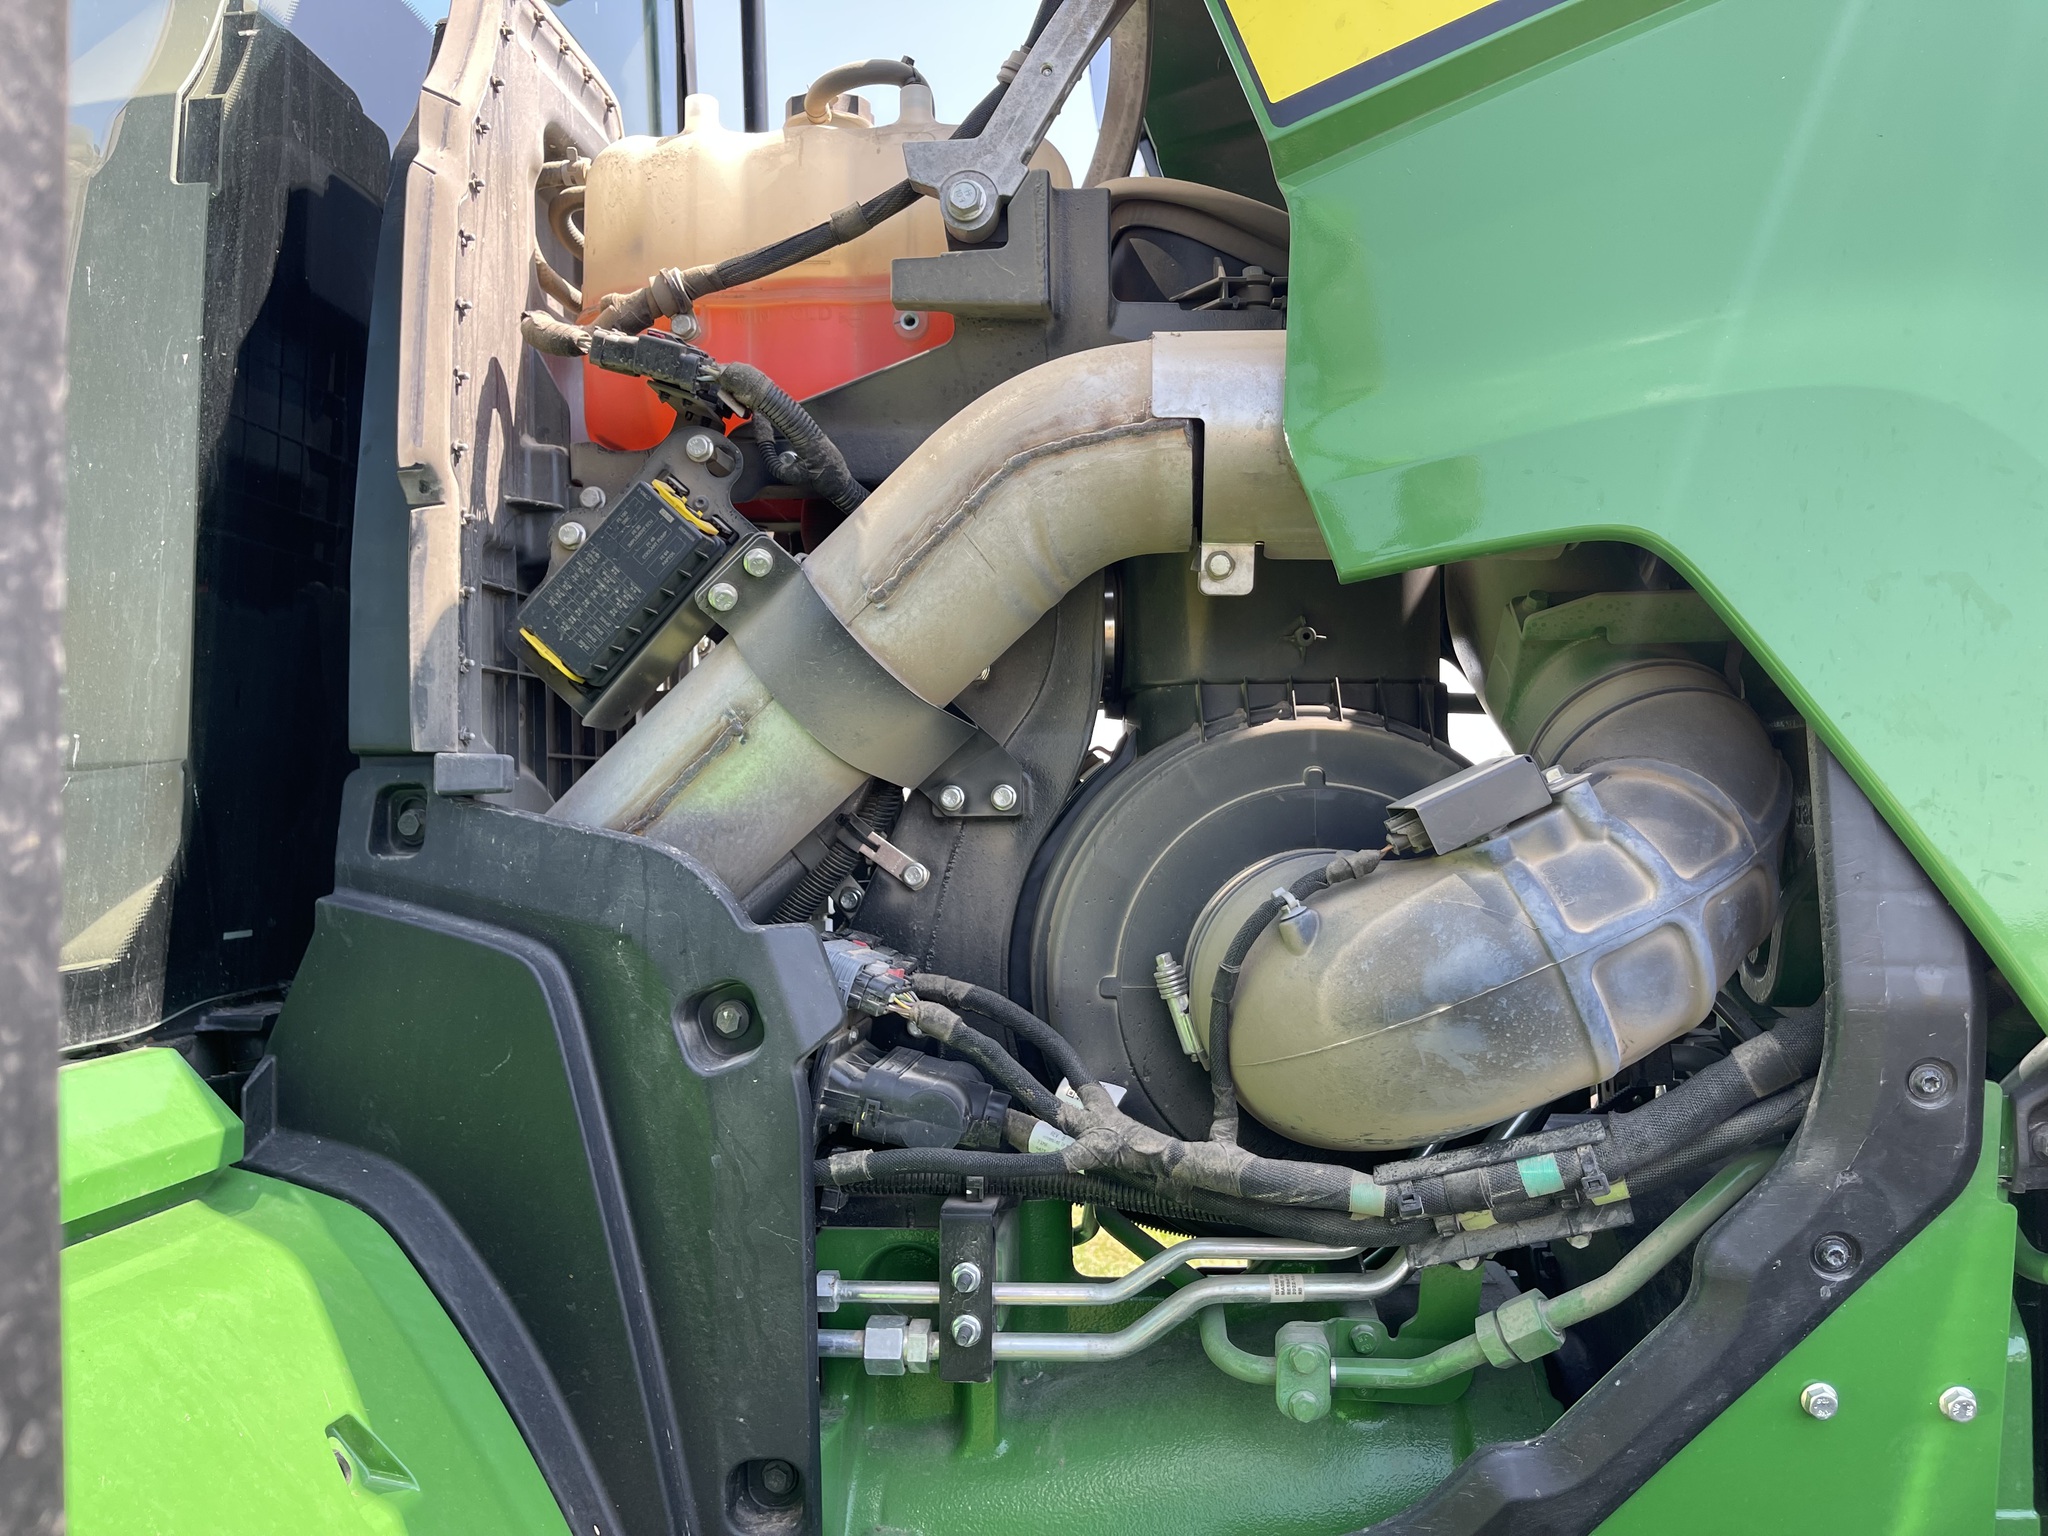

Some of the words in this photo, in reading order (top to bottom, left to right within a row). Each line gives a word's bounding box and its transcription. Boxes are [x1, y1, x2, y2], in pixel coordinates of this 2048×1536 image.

[642, 541, 659, 560] COOLANT
[656, 530, 668, 544] PUMP
[598, 614, 612, 628] SPARE
[591, 623, 605, 636] SPARE
[584, 630, 598, 643] SPARE
[576, 638, 591, 651] SPARE
